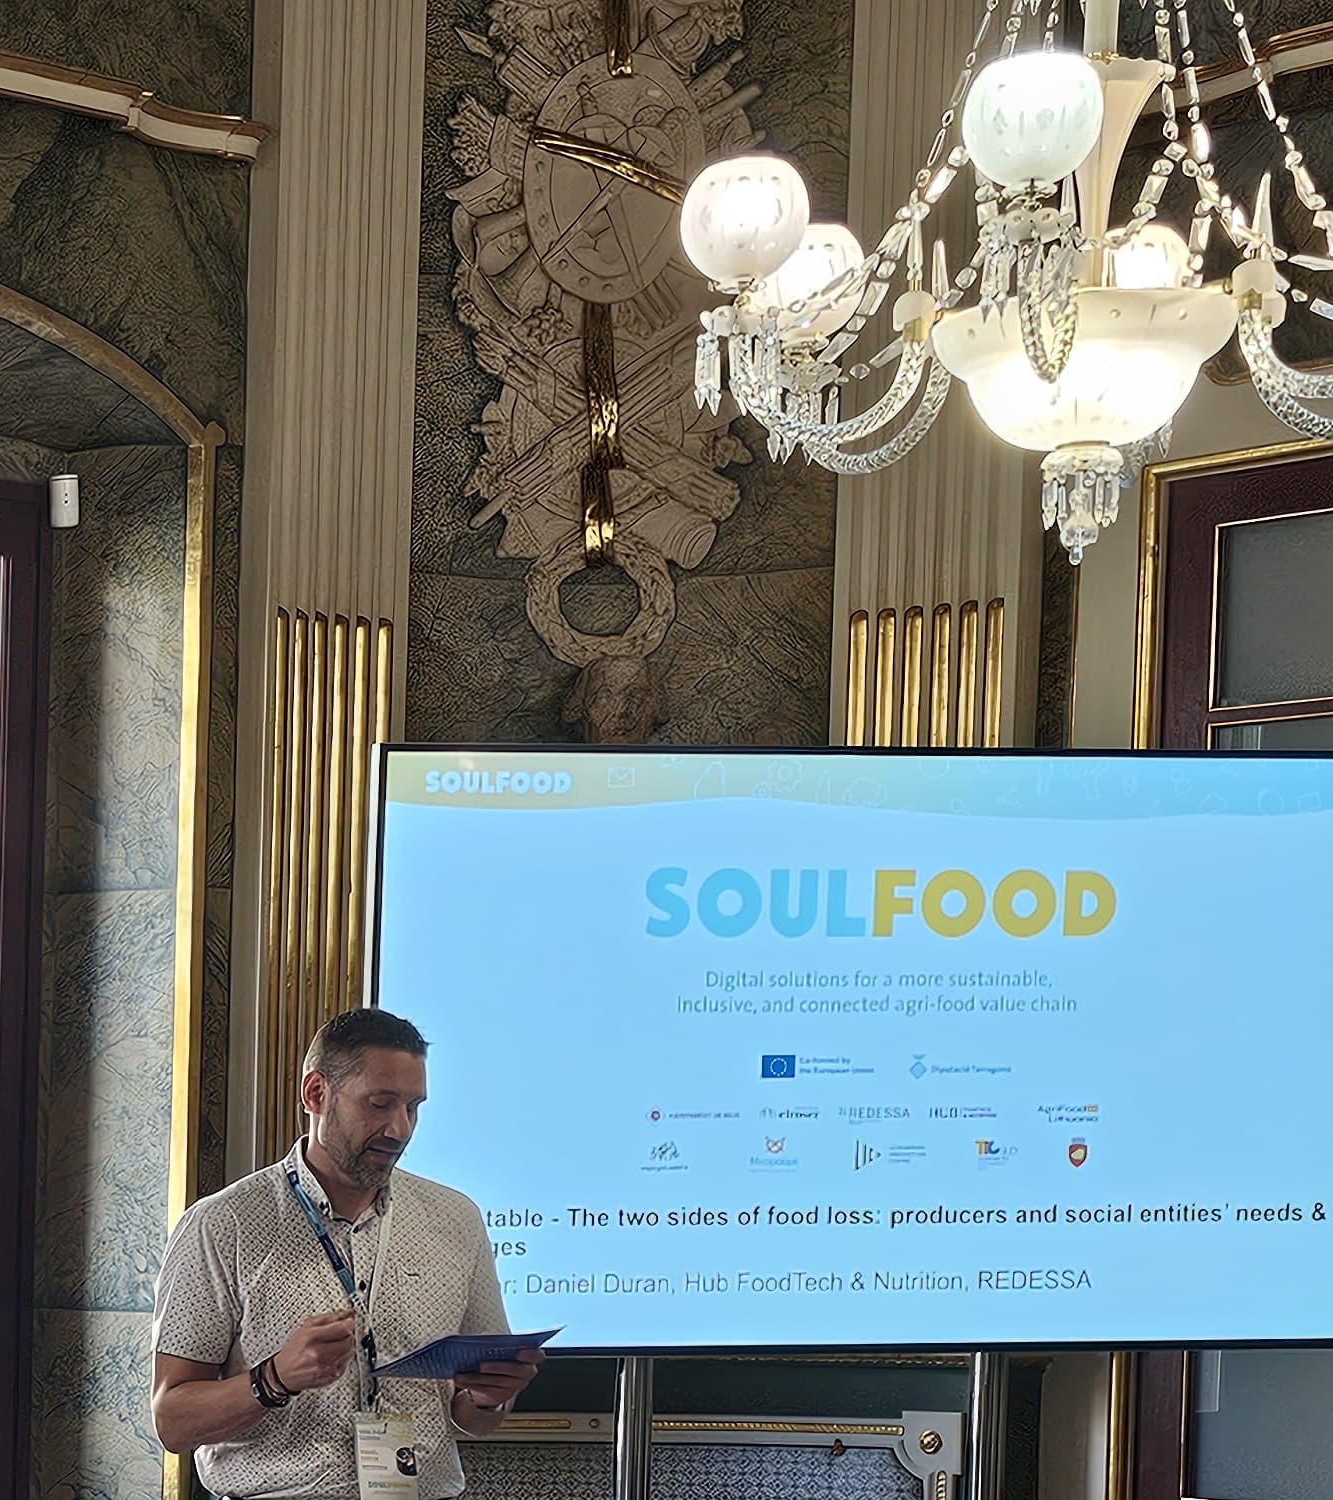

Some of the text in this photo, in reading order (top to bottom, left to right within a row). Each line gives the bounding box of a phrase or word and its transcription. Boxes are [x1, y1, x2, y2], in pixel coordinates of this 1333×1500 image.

[425, 770, 572, 794] SOULFOOD
[645, 867, 1117, 938] SOULFOOD
[706, 970, 1053, 991] Digital solutions for a more sustainable,
[762, 995, 794, 1013] and
[799, 995, 890, 1013] connected
[894, 995, 975, 1016] agri-food
[980, 997, 1025, 1013] value
[1031, 996, 1076, 1013] chain
[568, 1209, 609, 1226] The
[619, 1210, 659, 1226] two
[668, 1207, 728, 1226] sides
[738, 1207, 760, 1226] of
[768, 1206, 818, 1225] food
[828, 1205, 881, 1225] loss:
[890, 1206, 1007, 1229] producers
[1016, 1205, 1057, 1224] and
[1066, 1204, 1132, 1223] social
[1236, 1203, 1303, 1222] needs
[1311, 1203, 1326, 1221] &
[526, 1274, 595, 1294] Daniel
[604, 1274, 675, 1295] Duran,
[685, 1274, 728, 1292] Hub
[738, 1272, 843, 1292] FoodTech
[851, 1273, 865, 1292] &
[874, 1271, 970, 1292] Nutrition,
[978, 1270, 1091, 1290] REDESSA
